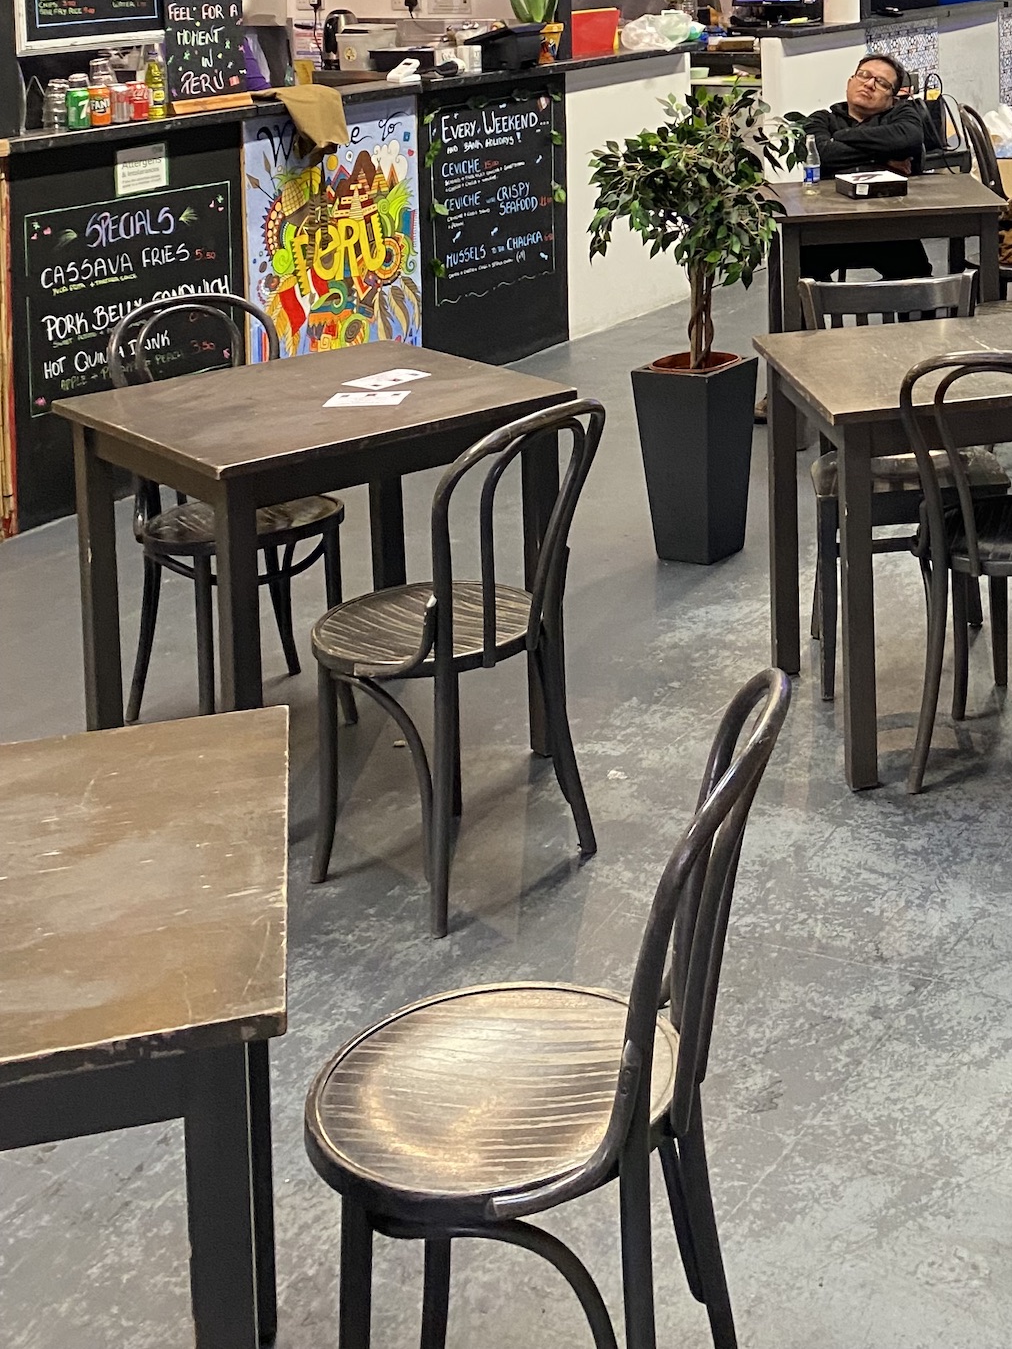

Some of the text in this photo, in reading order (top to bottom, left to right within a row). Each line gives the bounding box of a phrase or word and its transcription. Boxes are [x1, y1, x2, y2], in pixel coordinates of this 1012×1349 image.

[168, 3, 238, 21] FEEL FOR A
[177, 25, 225, 47] MOMENT
[201, 48, 213, 68] IN
[441, 114, 477, 143] EVERY
[441, 158, 481, 178] CEVICHE
[444, 191, 481, 211] CEVICHE
[496, 182, 530, 202] CRISPY
[499, 196, 539, 216] SEAFOOD
[85, 206, 176, 248] SPECIALS
[40, 252, 134, 289] CASSAVA
[141, 243, 190, 268] FRIES
[445, 244, 487, 268] MUSSELS
[40, 311, 89, 341] PORK
[43, 356, 66, 380] HOT
